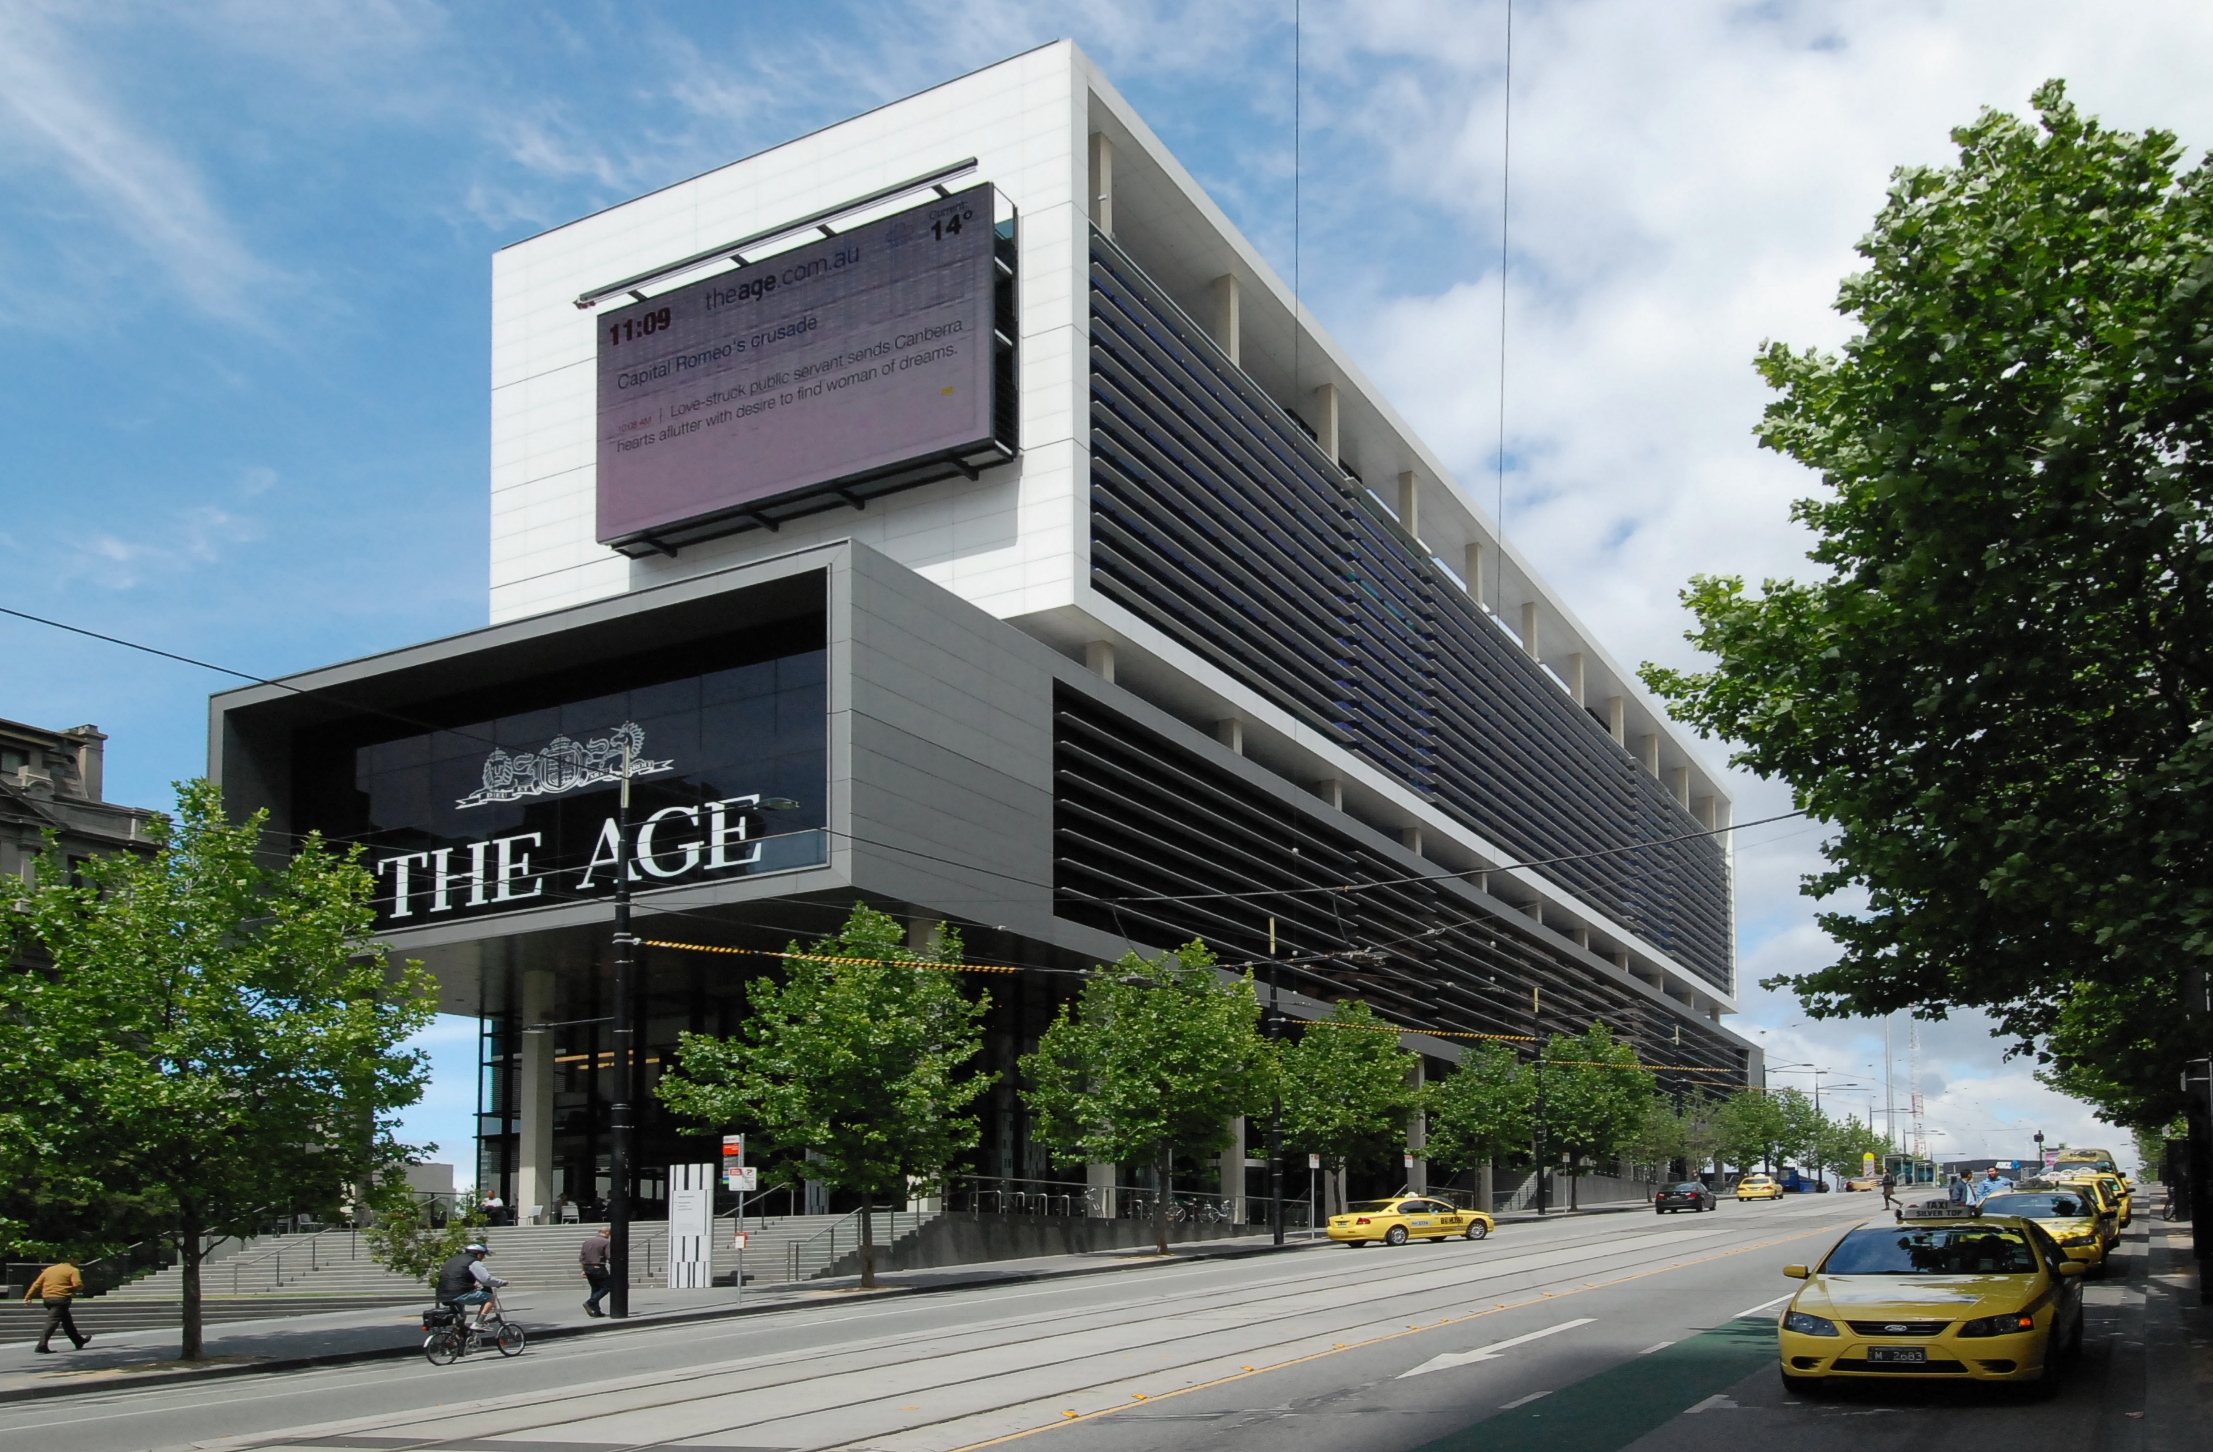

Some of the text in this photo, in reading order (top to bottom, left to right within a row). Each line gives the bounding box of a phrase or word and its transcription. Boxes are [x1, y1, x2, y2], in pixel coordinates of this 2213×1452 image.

[705, 247, 859, 311] theage.com.au
[610, 307, 671, 345] 11:09
[618, 317, 818, 389] Capital Romeo's crusade
[617, 344, 958, 452] hearts aflutter with desire to find woman of dreams.
[670, 384, 746, 418] Love-struck
[750, 371, 790, 397] public
[793, 355, 844, 380] servant
[848, 340, 890, 364] sends
[895, 320, 963, 349] Canberra
[377, 794, 762, 919] THE AGE
[1925, 1201, 1949, 1210] TAXI
[1874, 1351, 1923, 1361] M 2683
